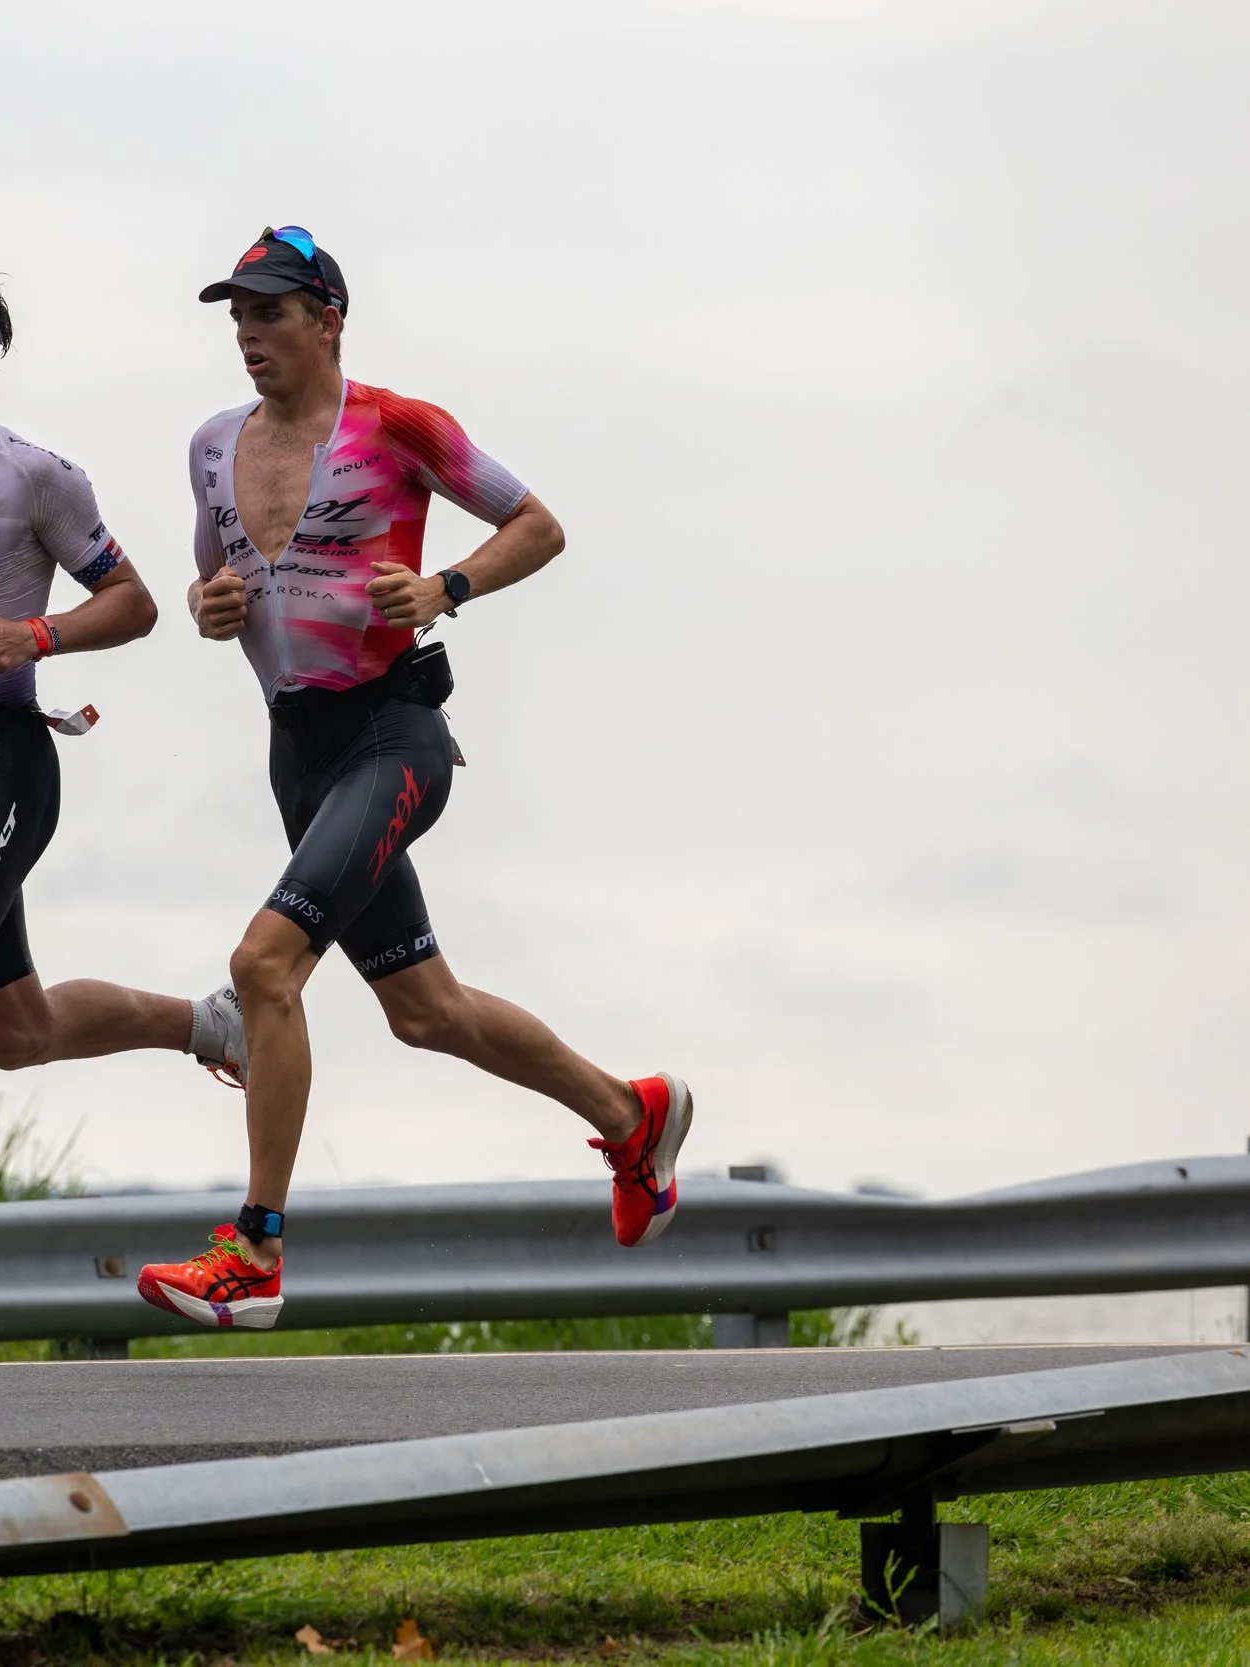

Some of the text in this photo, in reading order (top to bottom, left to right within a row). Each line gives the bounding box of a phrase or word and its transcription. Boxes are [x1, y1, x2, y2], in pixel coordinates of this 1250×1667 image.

[333, 454, 381, 477] ROUVY
[294, 547, 360, 556] RACING
[272, 889, 325, 924] SWISS
[355, 931, 435, 974] SWISS DT
